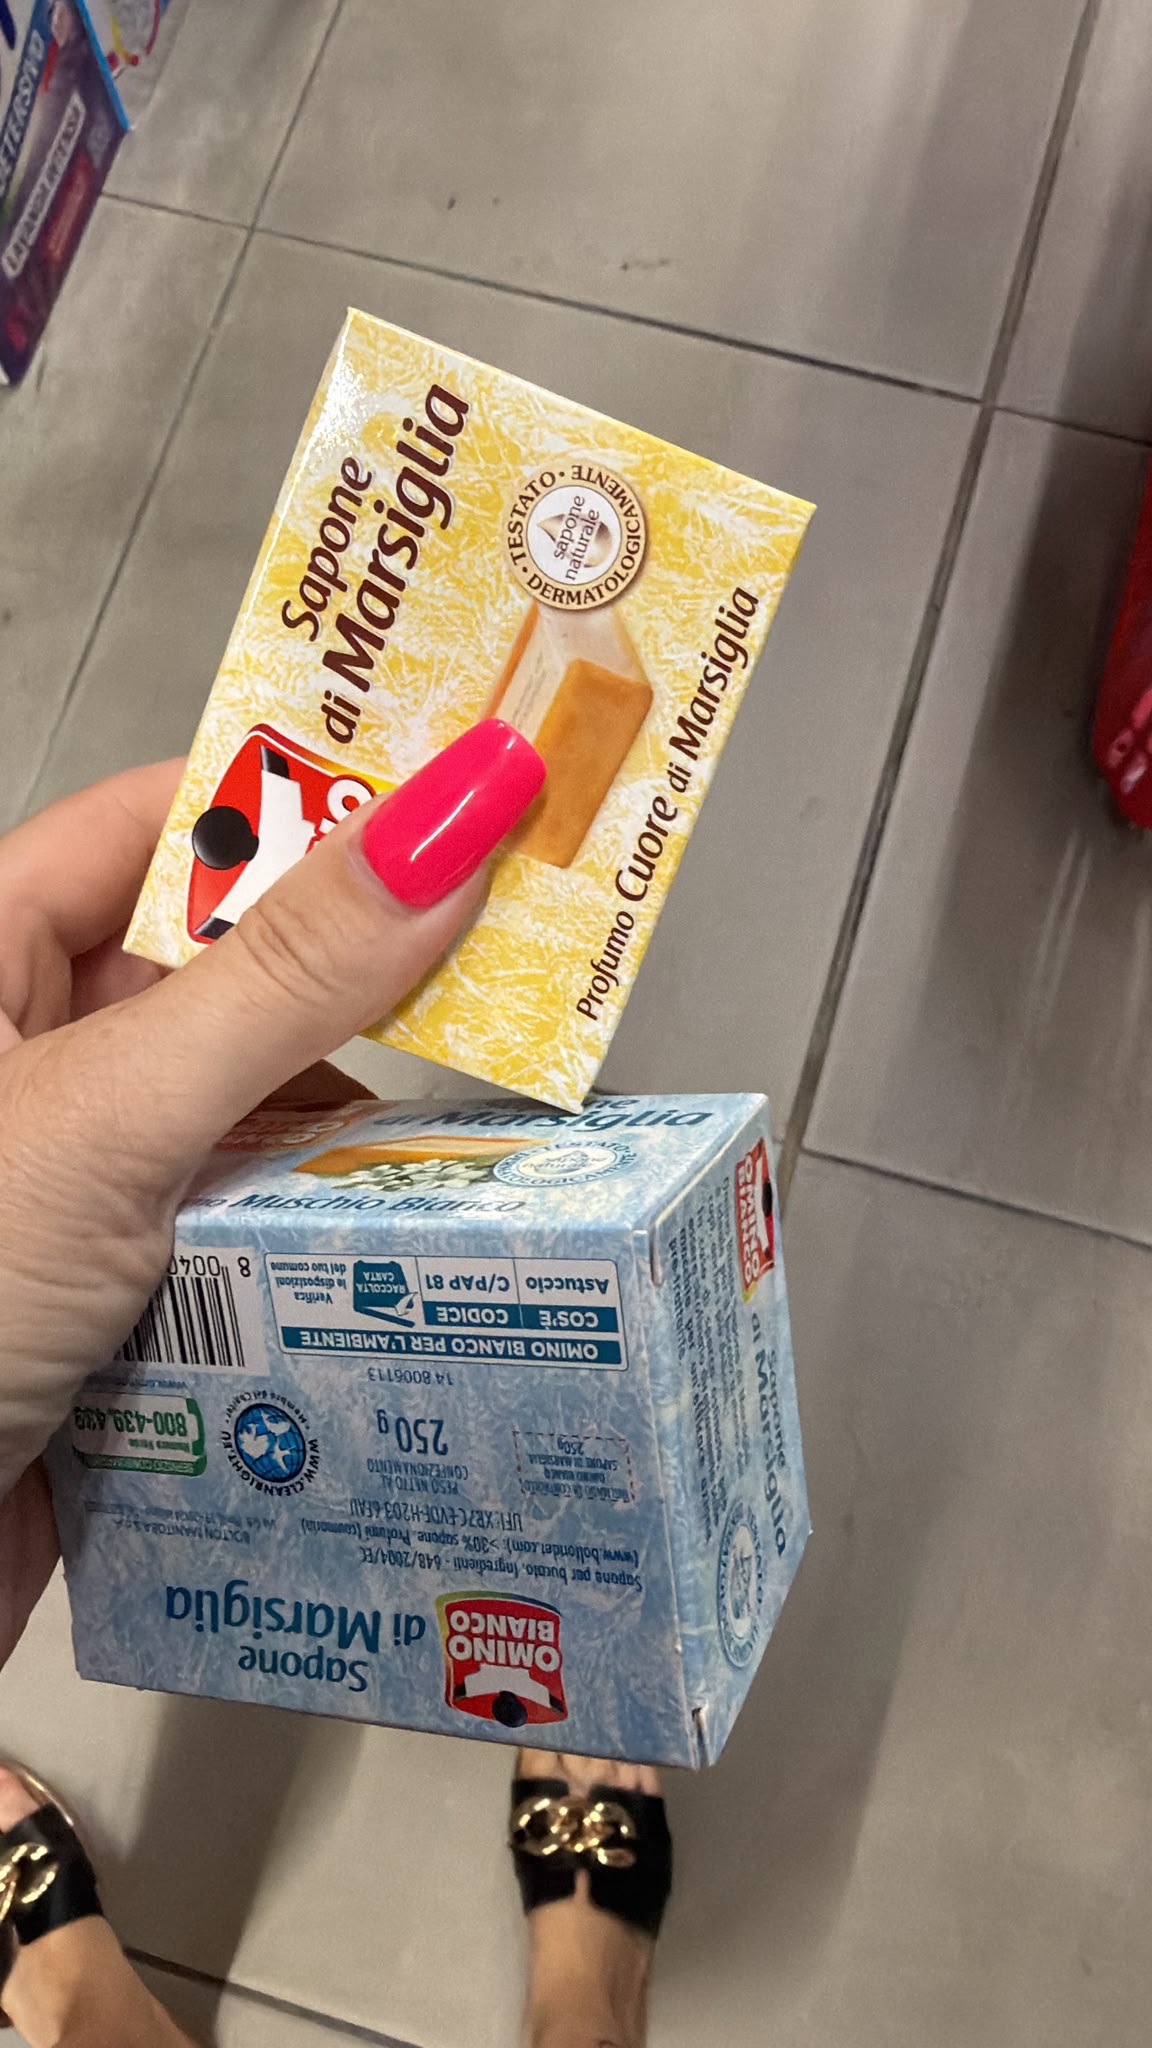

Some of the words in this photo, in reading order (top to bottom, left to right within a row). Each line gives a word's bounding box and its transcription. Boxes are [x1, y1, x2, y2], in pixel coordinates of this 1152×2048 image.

[507, 471, 556, 566] TESTATO
[553, 495, 586, 561] sapone
[321, 384, 470, 693] Marsiglia
[526, 464, 642, 606] DERMATOLOGICAMENTE
[565, 509, 600, 581] naturale
[281, 457, 373, 642] Sapone
[668, 587, 759, 761] Marsiglia
[321, 690, 361, 743] di
[667, 762, 692, 793] di
[615, 796, 678, 902] Cuore
[576, 910, 635, 1021] Profumo
[420, 1108, 713, 1132] Marsiglia
[230, 1194, 386, 1209] Muschio
[387, 1196, 527, 1212] Bianco
[737, 1165, 752, 1284] BIANCO
[743, 1154, 760, 1278] OMINO
[237, 1256, 251, 1278] 8
[270, 1261, 310, 1272] comune
[311, 1262, 329, 1273] tuo
[330, 1262, 347, 1276] del
[362, 1271, 395, 1282] CARTA
[275, 1276, 335, 1290] disposizioni
[336, 1278, 347, 1290] le
[356, 1283, 406, 1294] RACCOLTA
[425, 1274, 444, 1290] 81
[449, 1275, 510, 1292] C/PAP
[525, 1276, 609, 1295] Astuccio
[293, 1291, 334, 1305] Verifica
[436, 1306, 509, 1324] CODICE
[410, 1335, 447, 1353] PER
[451, 1338, 526, 1356] BIANCO
[531, 1341, 599, 1360] OMINO
[367, 1367, 431, 1385] 8006113
[435, 1372, 454, 1386] 14
[767, 1349, 786, 1469] Sapone
[376, 1409, 389, 1434] g
[395, 1416, 448, 1456] 250
[556, 1437, 585, 1456] 250g
[222, 1431, 319, 1496] WWW.CLEANRIGHT.EU
[755, 1349, 786, 1557] Marsiglia
[431, 1478, 459, 1496] PESO
[461, 1535, 500, 1554] >30%
[453, 1557, 519, 1579] Ingredienti
[571, 1567, 591, 1582] per
[595, 1570, 643, 1593] Sapone
[166, 1580, 381, 1653] Marsiglia
[450, 1610, 555, 1642] BIANCO
[393, 1613, 426, 1646] di
[446, 1634, 560, 1672] OMINO
[238, 1645, 368, 1692] Sapone
